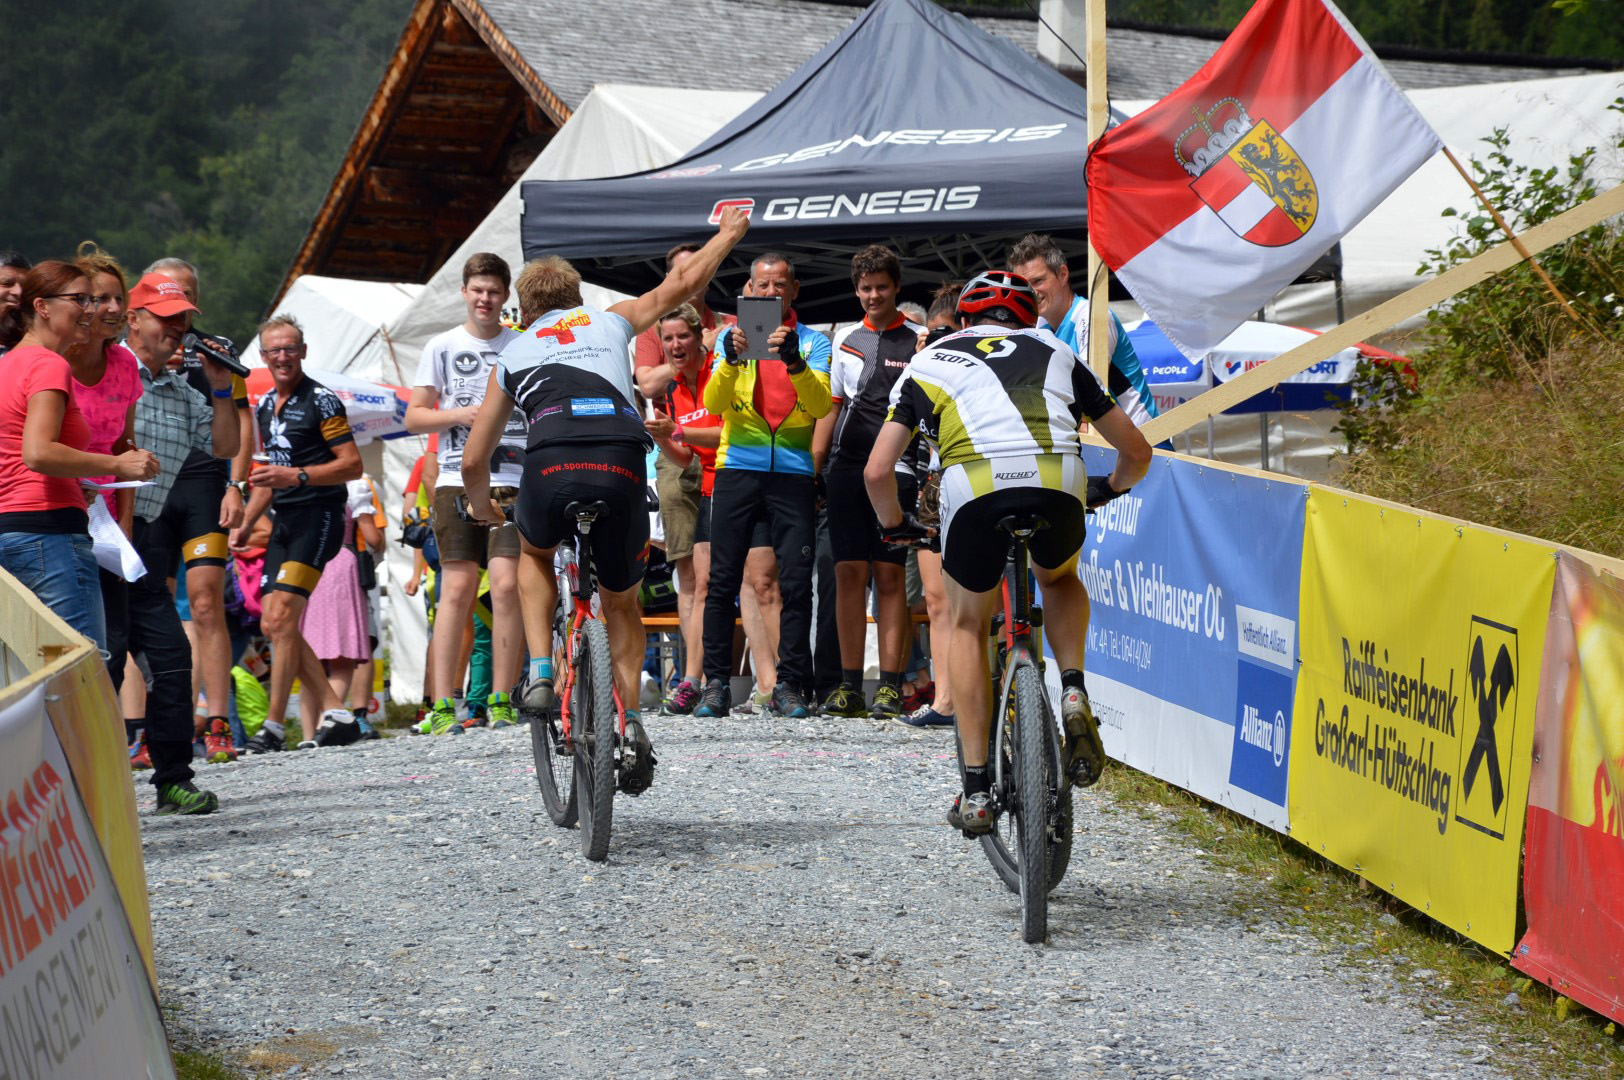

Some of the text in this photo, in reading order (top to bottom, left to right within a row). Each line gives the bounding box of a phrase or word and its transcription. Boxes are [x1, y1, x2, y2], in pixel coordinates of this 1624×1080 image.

[730, 123, 1067, 172] GENESIS
[763, 186, 981, 221] GENESIS
[885, 359, 909, 369] beng
[930, 352, 978, 367] SCOTT
[1152, 366, 1188, 375] PEOPLE
[453, 378, 465, 388] 72
[678, 408, 709, 424] SCOT
[994, 470, 1037, 480] RITCHEY
[1115, 559, 1129, 612] &
[1127, 561, 1203, 634] Viehhauser
[1242, 621, 1271, 650] Hoffentlich
[1342, 637, 1458, 737] Raiffeisenbank
[1240, 704, 1273, 752] Allianz
[1315, 698, 1451, 835] Großarl-Hüttschlag
[0, 907, 120, 1080] NAGEMENT
